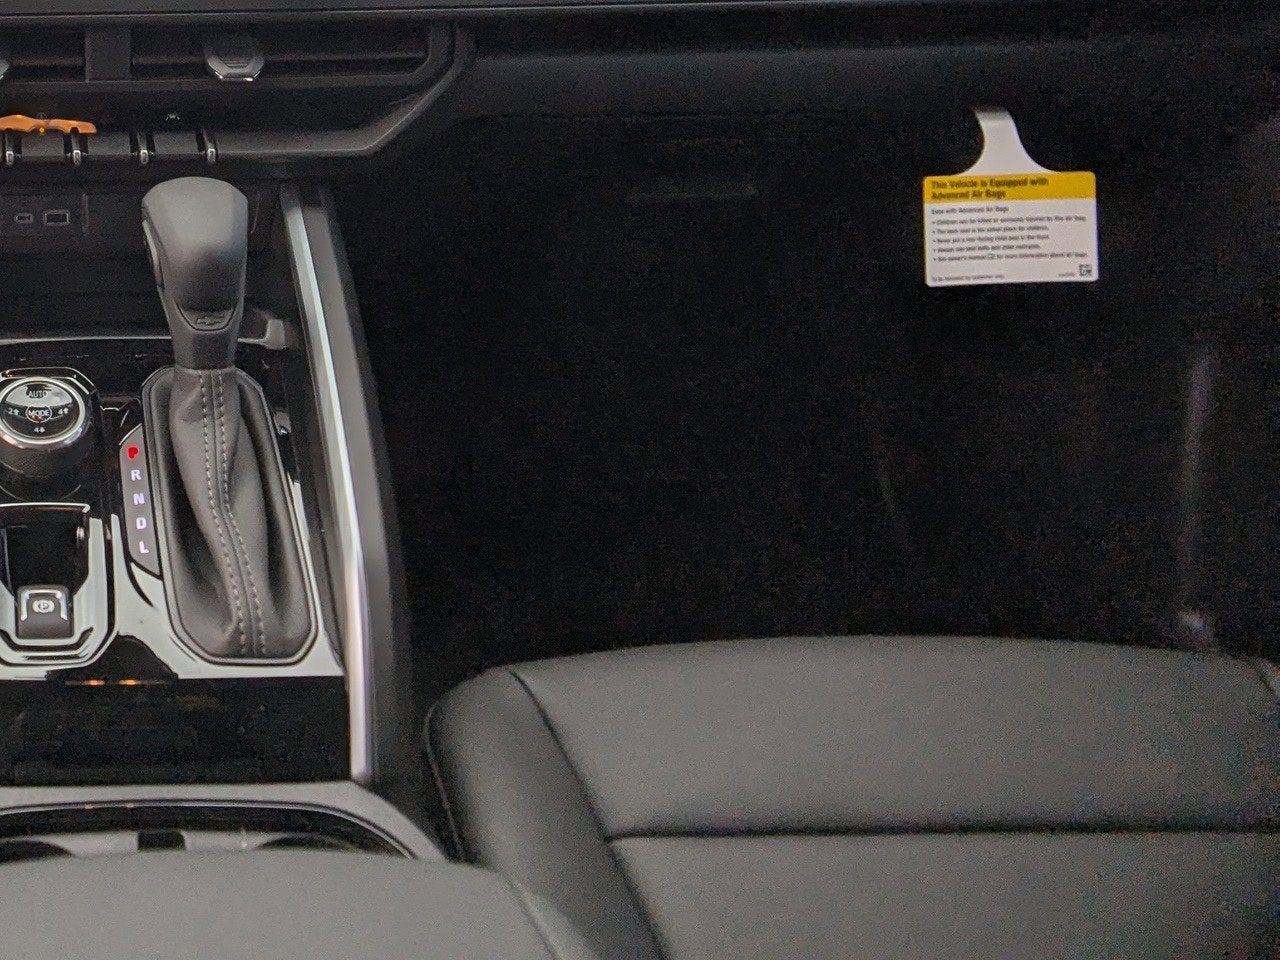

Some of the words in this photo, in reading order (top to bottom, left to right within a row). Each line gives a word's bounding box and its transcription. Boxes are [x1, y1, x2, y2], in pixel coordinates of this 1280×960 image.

[949, 179, 977, 188] Vehicle
[989, 178, 1028, 188] Equipped
[931, 190, 969, 199] Advanced
[972, 190, 982, 198] Air
[985, 189, 1007, 199] Bags
[28, 390, 48, 398] AUTO
[28, 408, 50, 416] MODE
[127, 446, 139, 460] P
[130, 469, 142, 481] R
[133, 492, 145, 506] N
[136, 517, 147, 530] D
[139, 541, 150, 554] L
